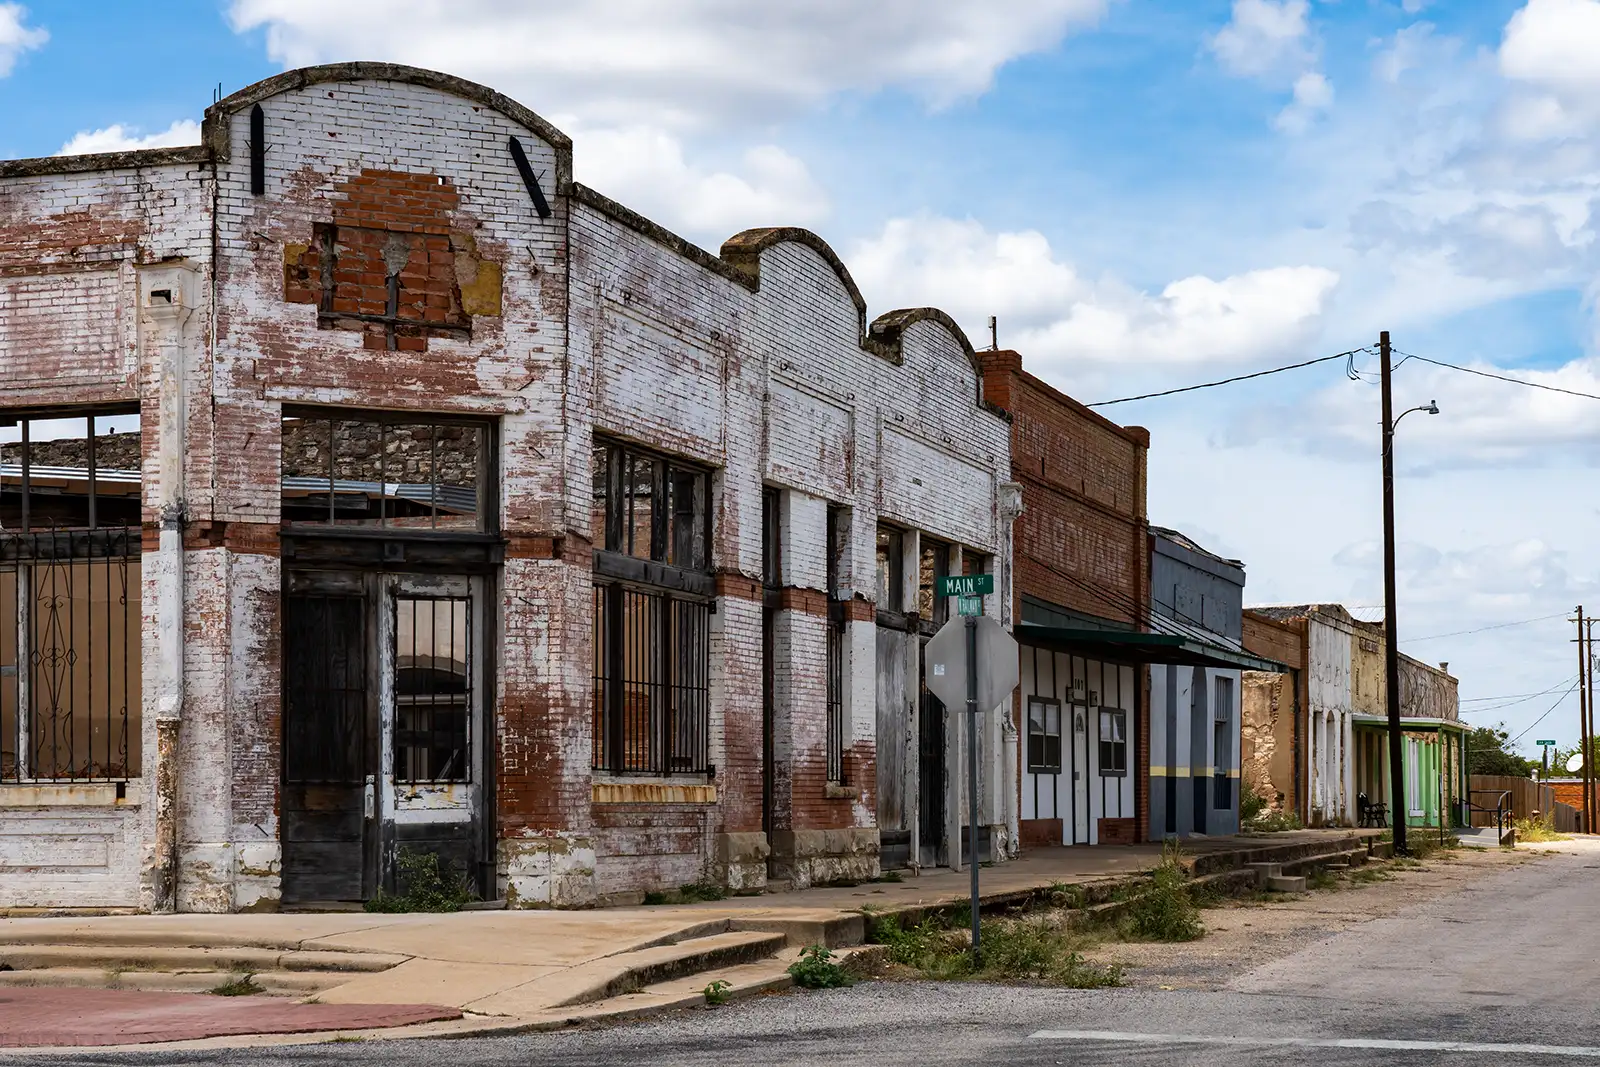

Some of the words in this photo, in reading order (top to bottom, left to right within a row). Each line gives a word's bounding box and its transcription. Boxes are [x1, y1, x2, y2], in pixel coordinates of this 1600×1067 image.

[1023, 504, 1128, 588] HARDWARE
[946, 578, 974, 593] MAIN
[977, 577, 984, 586] ST
